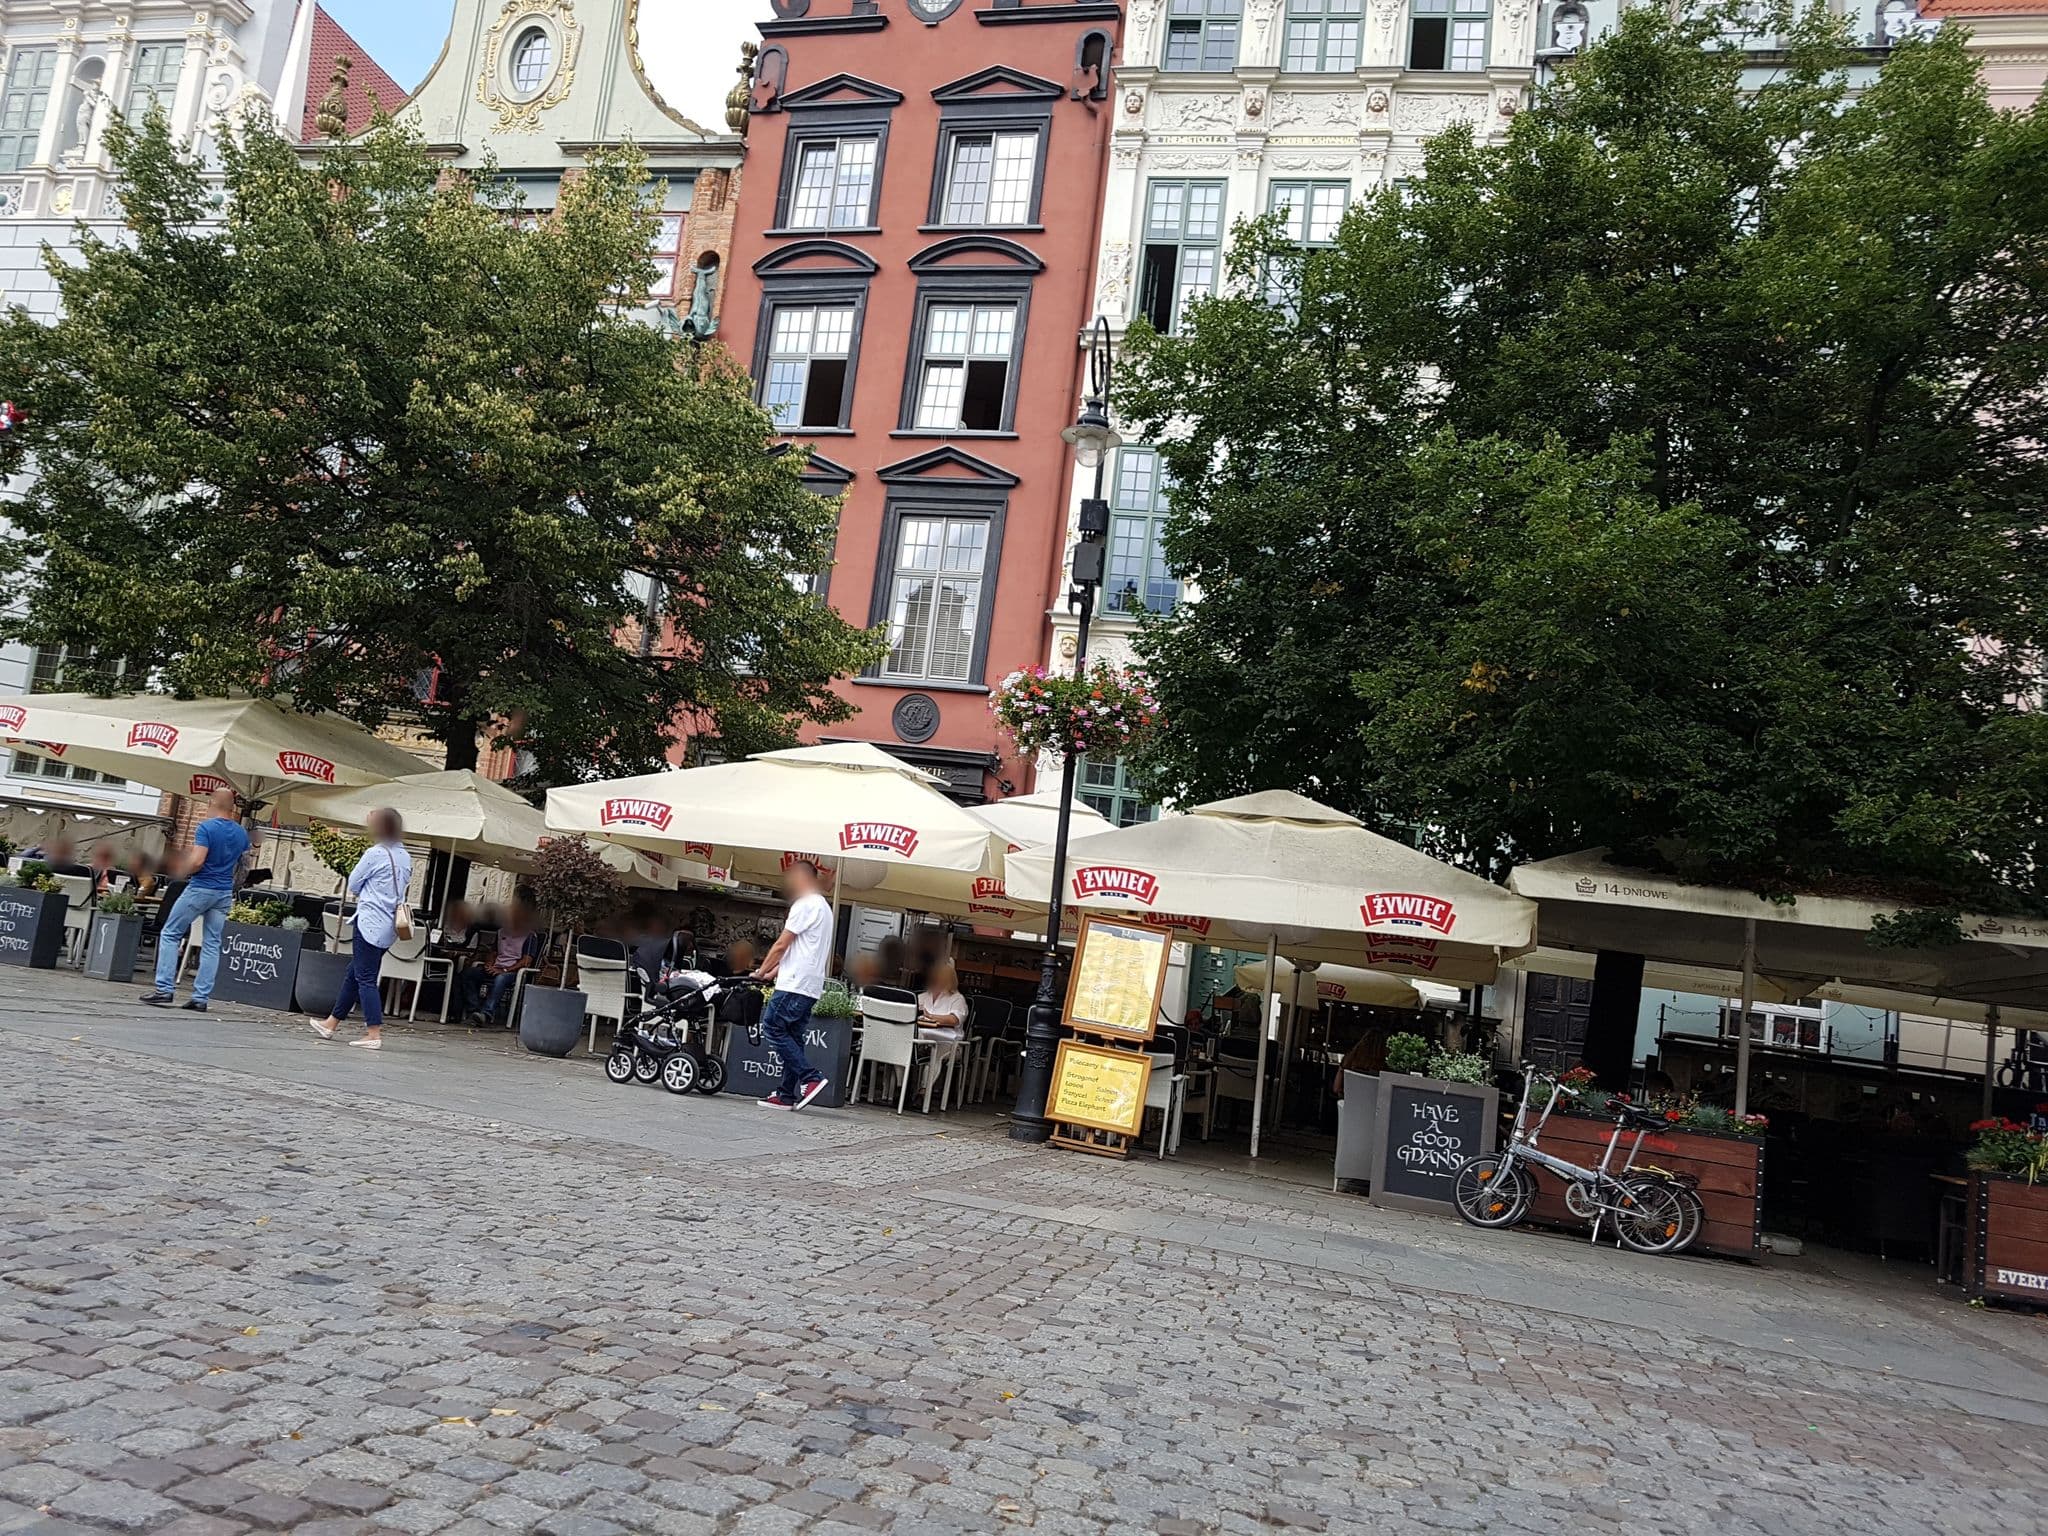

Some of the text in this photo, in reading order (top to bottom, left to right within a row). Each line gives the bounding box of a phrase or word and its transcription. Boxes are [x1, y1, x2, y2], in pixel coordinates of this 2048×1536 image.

[134, 723, 175, 745] ŻYWIEC
[283, 752, 330, 777] ŻYWIEC
[610, 799, 667, 821] ŻYWIEC
[850, 823, 912, 847] ŻYWIEC
[1083, 869, 1150, 893] ŻYWIEC
[1604, 883, 1620, 896] 14
[1623, 887, 1669, 900] DNIOWE
[0, 900, 36, 918] COFFEE
[1373, 894, 1446, 922] ŻYWIEC
[2011, 924, 2029, 937] 14
[1411, 1102, 1460, 1123] HAVE
[1425, 1119, 1444, 1134] A
[1412, 1131, 1462, 1150] GOOD
